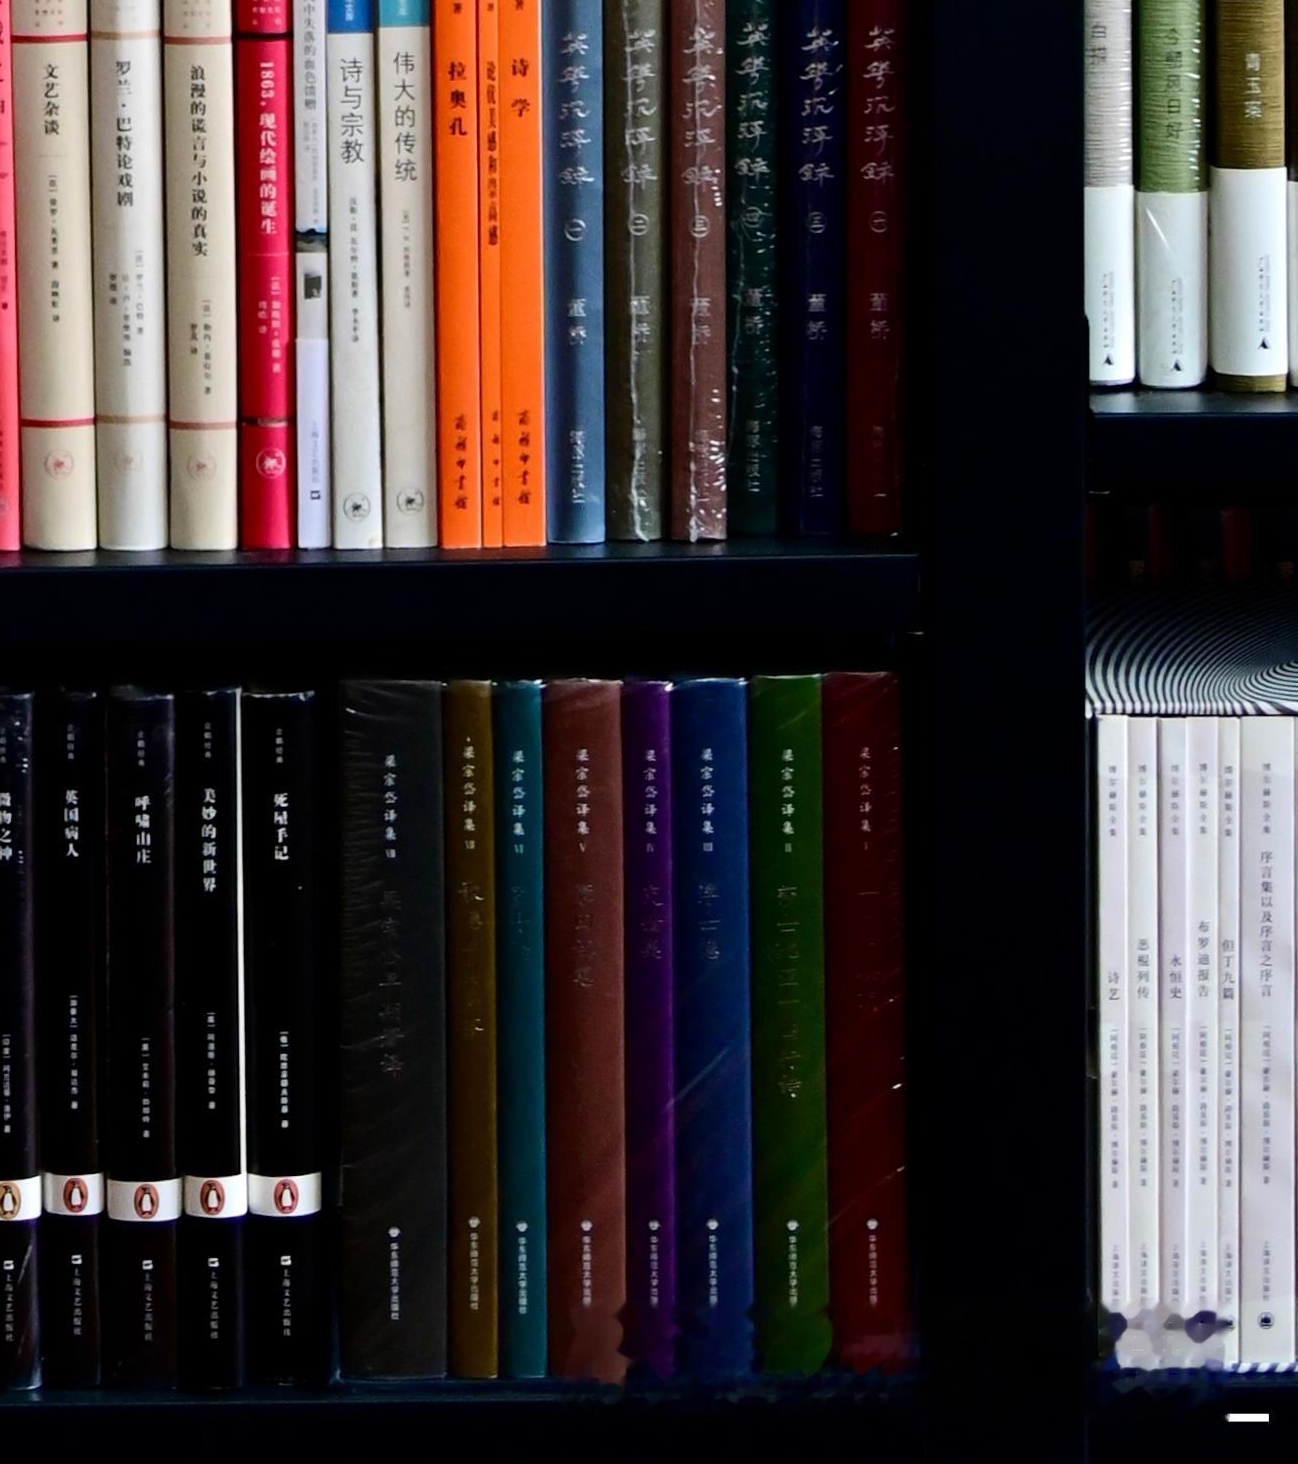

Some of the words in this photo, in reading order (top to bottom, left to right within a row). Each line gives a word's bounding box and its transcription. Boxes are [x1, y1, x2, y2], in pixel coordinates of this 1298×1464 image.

[340, 57, 364, 165] 诗与宗教
[394, 51, 416, 182] 伟大的传统
[1259, 850, 1274, 998] 序言集以及序言之序言
